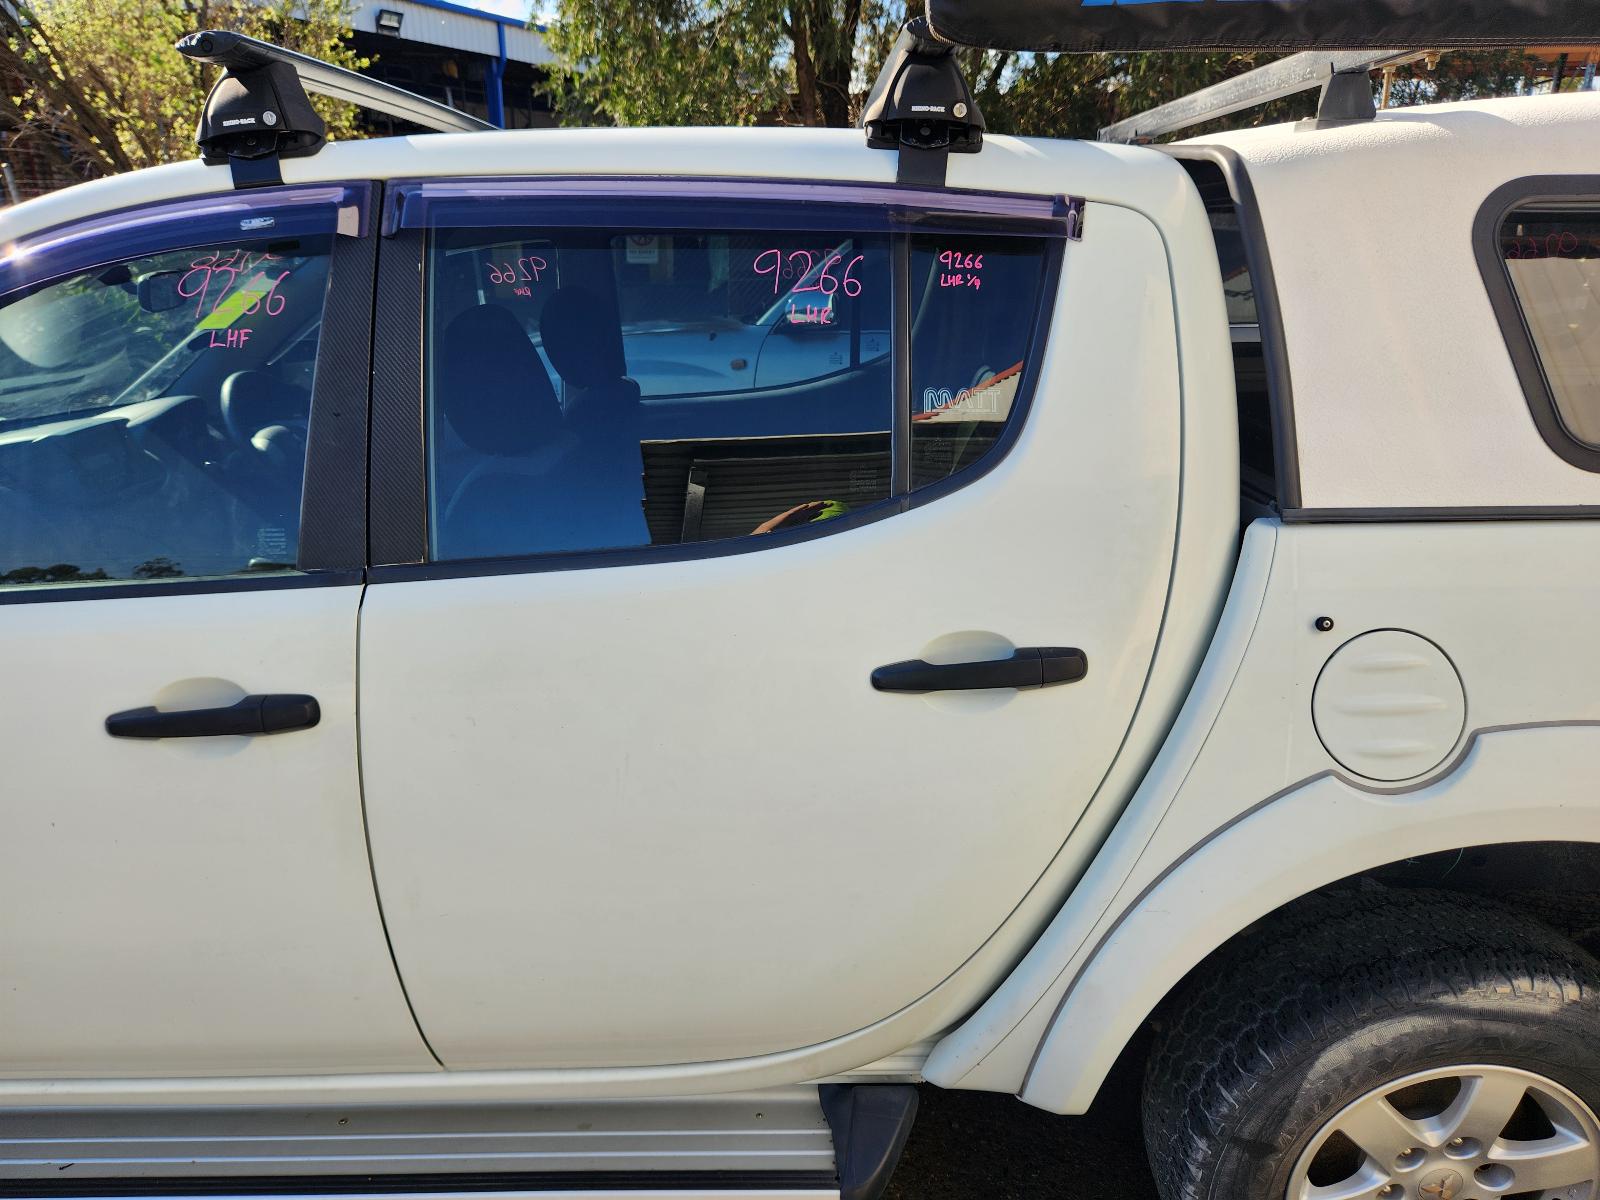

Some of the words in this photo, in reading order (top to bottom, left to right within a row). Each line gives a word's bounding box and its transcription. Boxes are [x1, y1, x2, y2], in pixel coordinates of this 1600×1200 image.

[940, 250, 984, 270] 9266
[753, 249, 865, 297] 9266
[941, 273, 964, 287] LHR
[178, 266, 290, 318] 9266
[790, 303, 833, 325] LHR
[209, 328, 253, 349] LHF
